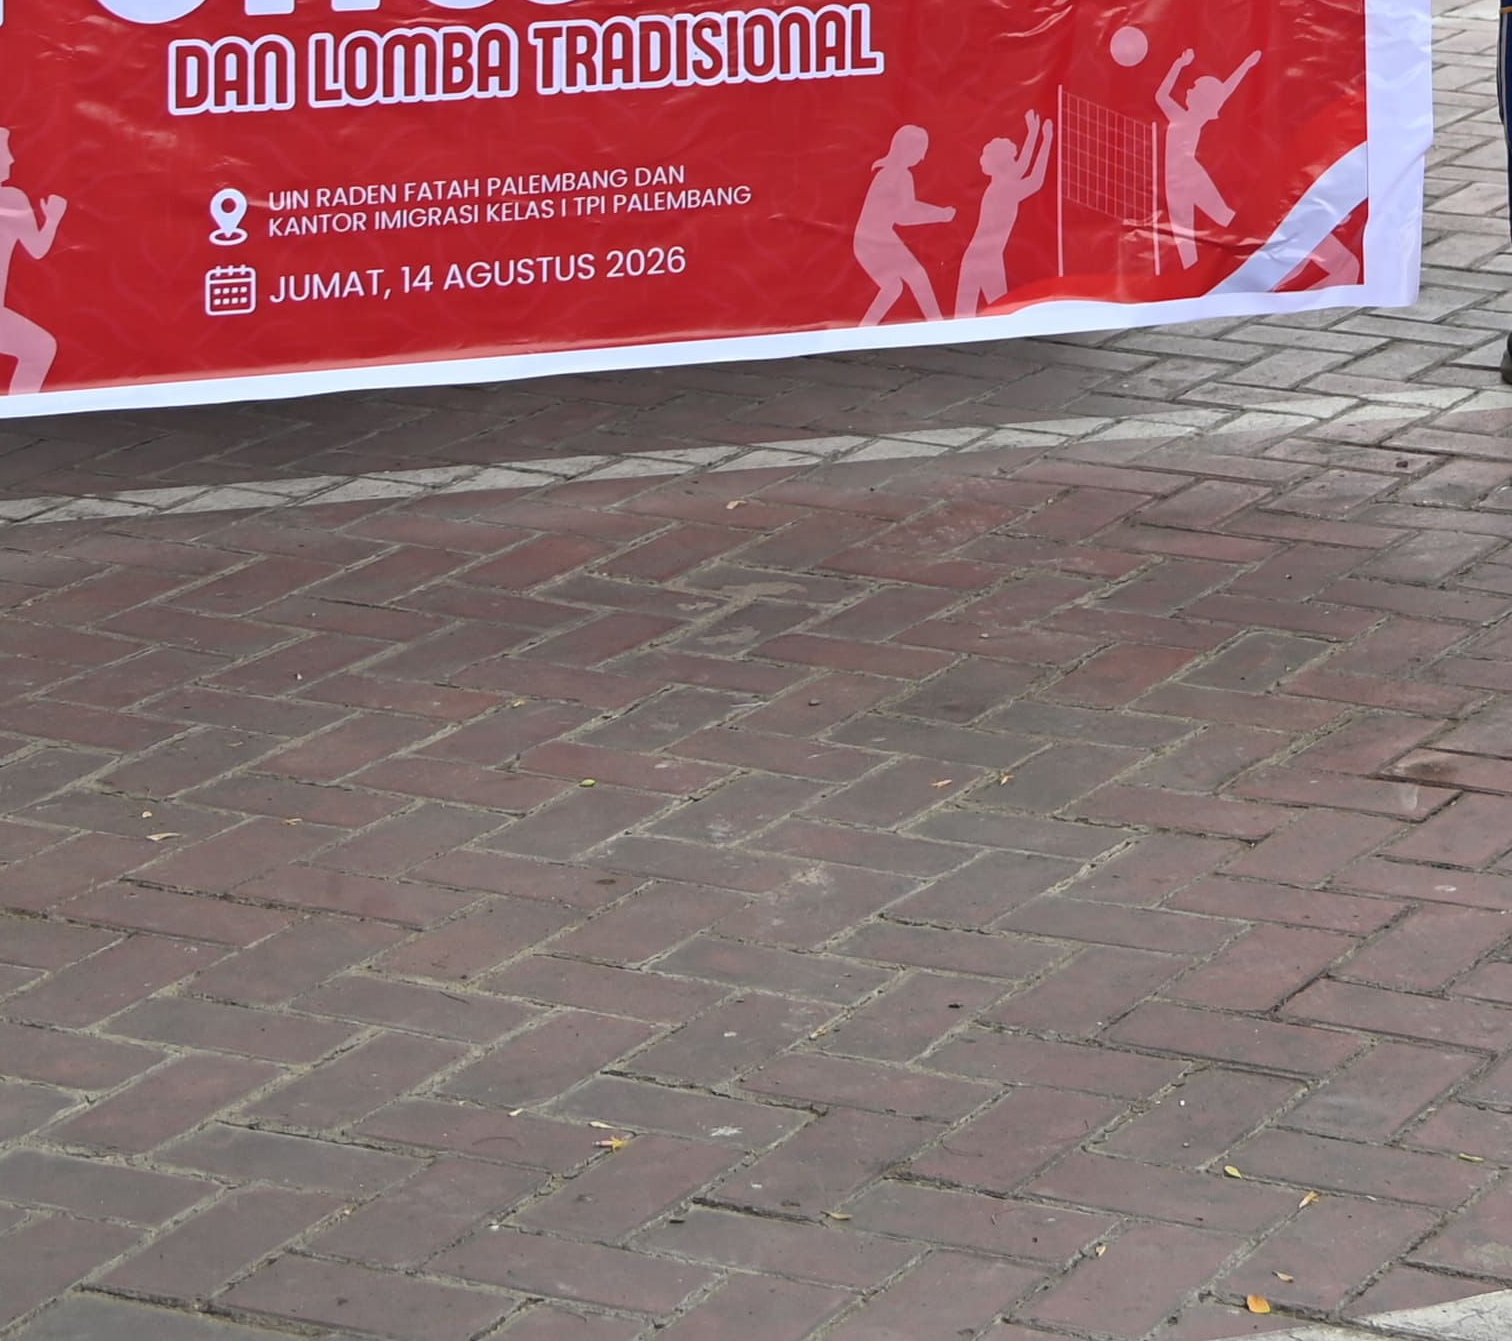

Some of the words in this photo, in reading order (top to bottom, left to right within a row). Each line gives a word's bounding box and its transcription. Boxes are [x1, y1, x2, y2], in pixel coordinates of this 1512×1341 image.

[168, 32, 294, 115] DAN
[307, 20, 517, 109] LOMBA
[527, 1, 883, 93] TRADISIONAL
[268, 188, 310, 211] UIN
[316, 184, 397, 207] RADEN
[403, 178, 480, 202] FATAH
[487, 169, 629, 197] PALEMBANG
[634, 165, 685, 187] DAN
[268, 212, 367, 237] KANTOR
[374, 205, 479, 230] IMIGRASI
[486, 199, 555, 223] KELAS
[561, 198, 567, 217] I
[574, 195, 606, 216] TPI
[613, 185, 752, 214] PALEMBANG
[269, 269, 392, 303] JUMAT,
[400, 265, 434, 293] 14
[443, 253, 596, 291] AGUSTUS
[606, 246, 687, 278] 2026
